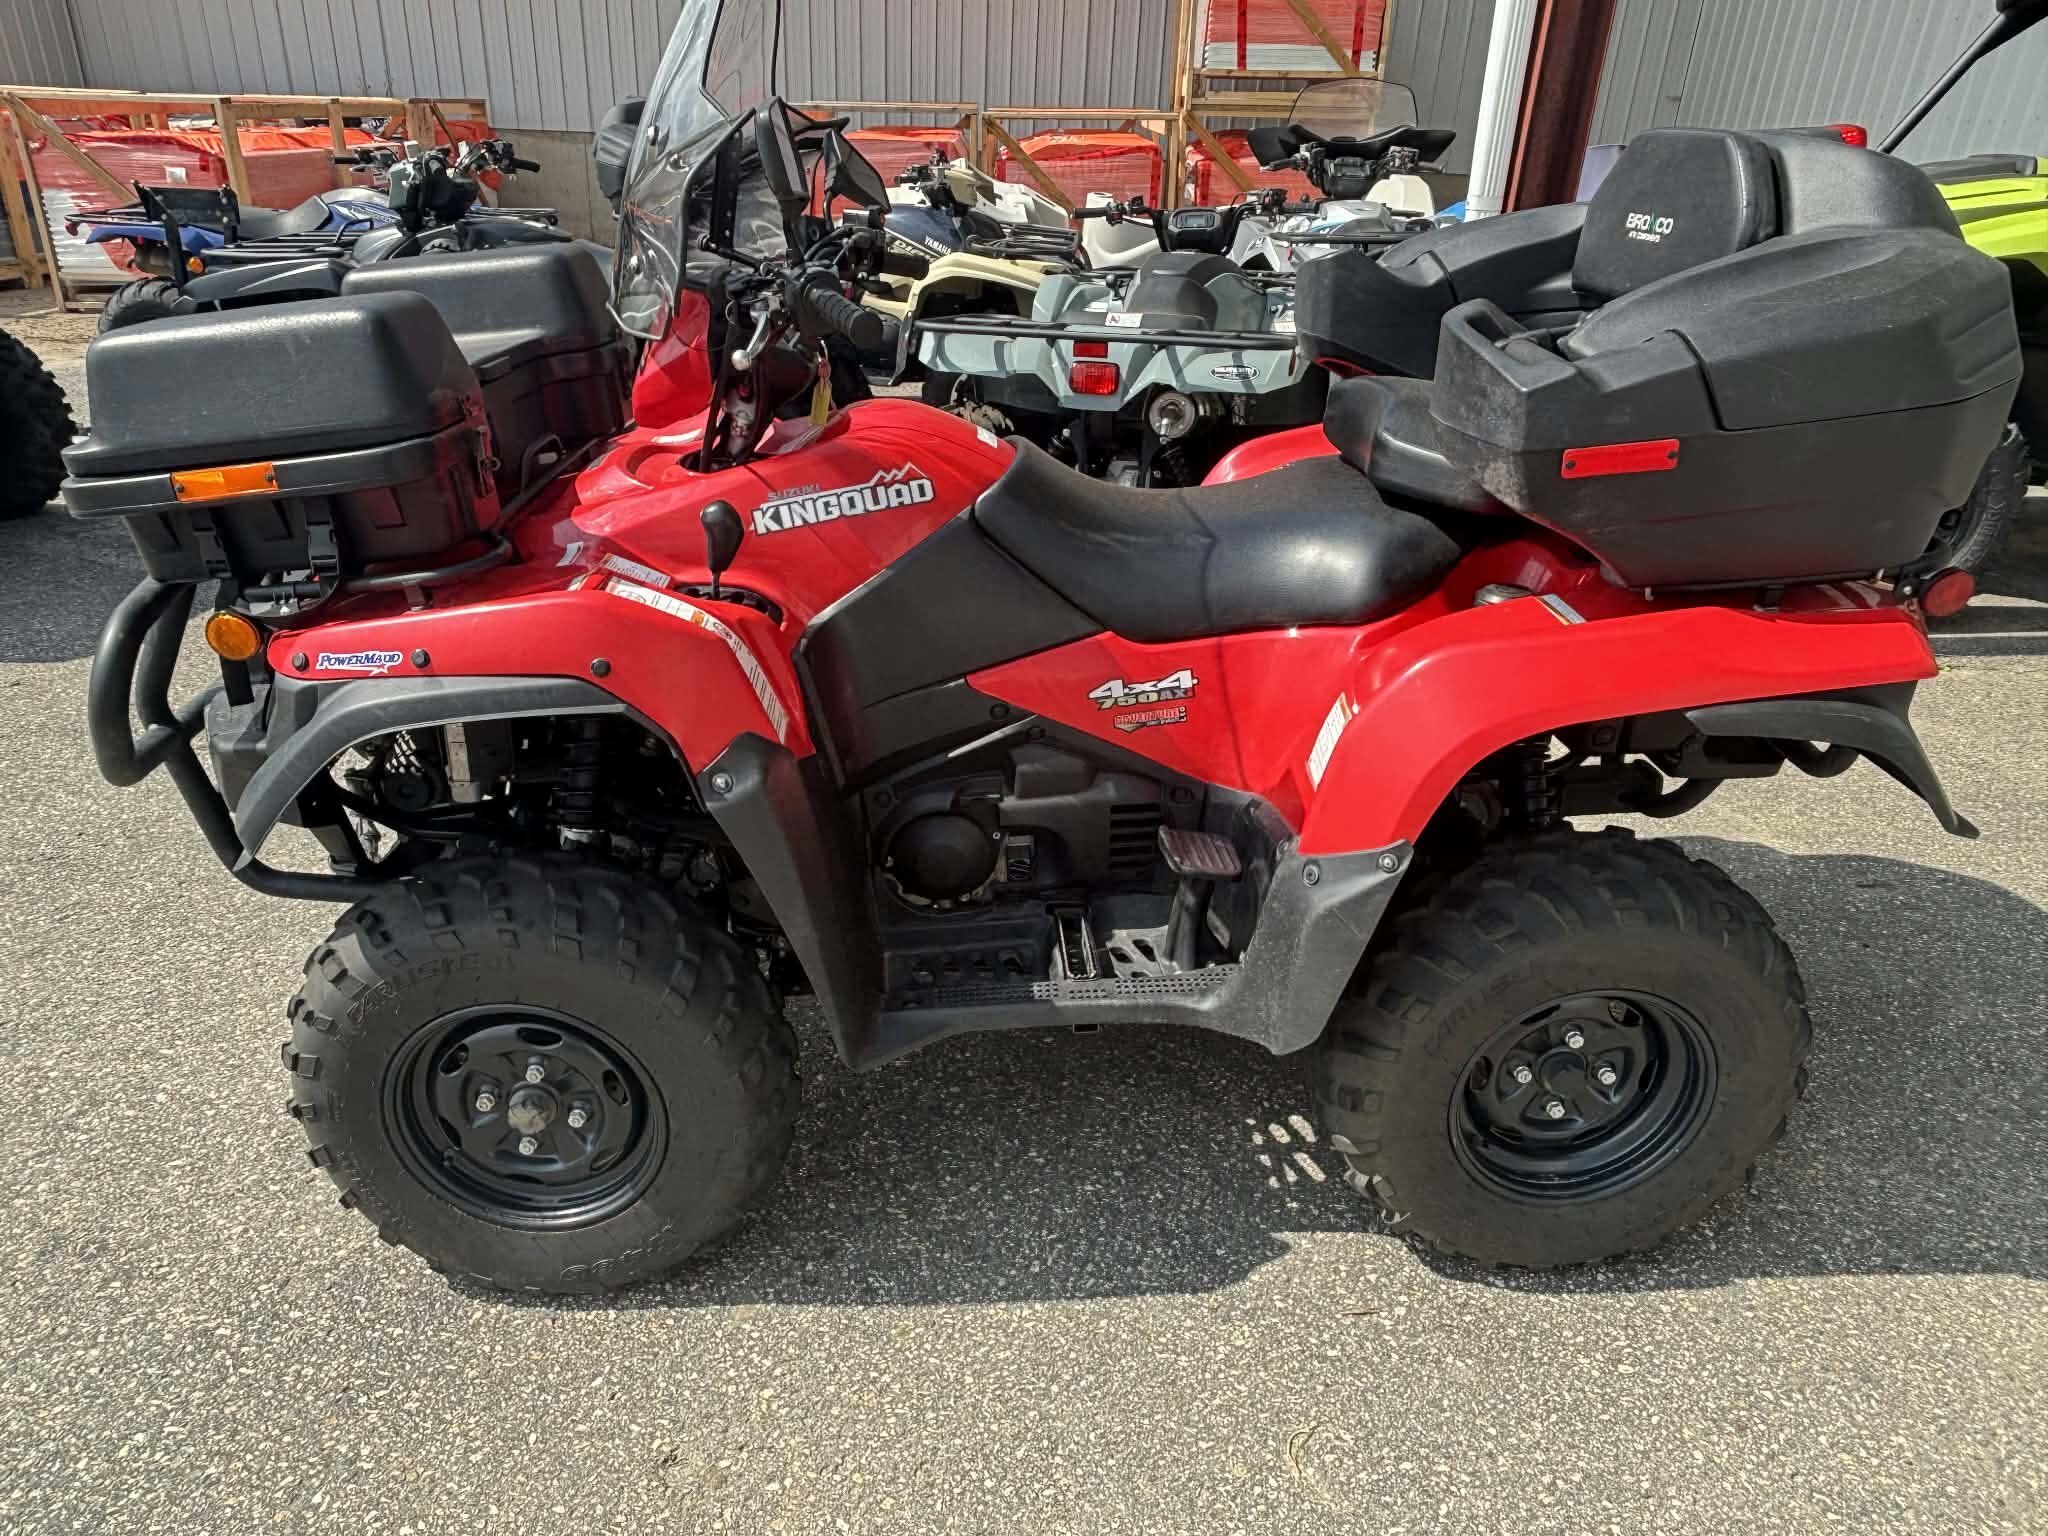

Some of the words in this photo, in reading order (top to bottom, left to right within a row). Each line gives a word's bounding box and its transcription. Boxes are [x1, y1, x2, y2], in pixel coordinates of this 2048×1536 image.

[924, 235, 952, 255] YAMAHA
[767, 483, 821, 500] SUZUKI
[752, 478, 936, 536] KINGQUAD
